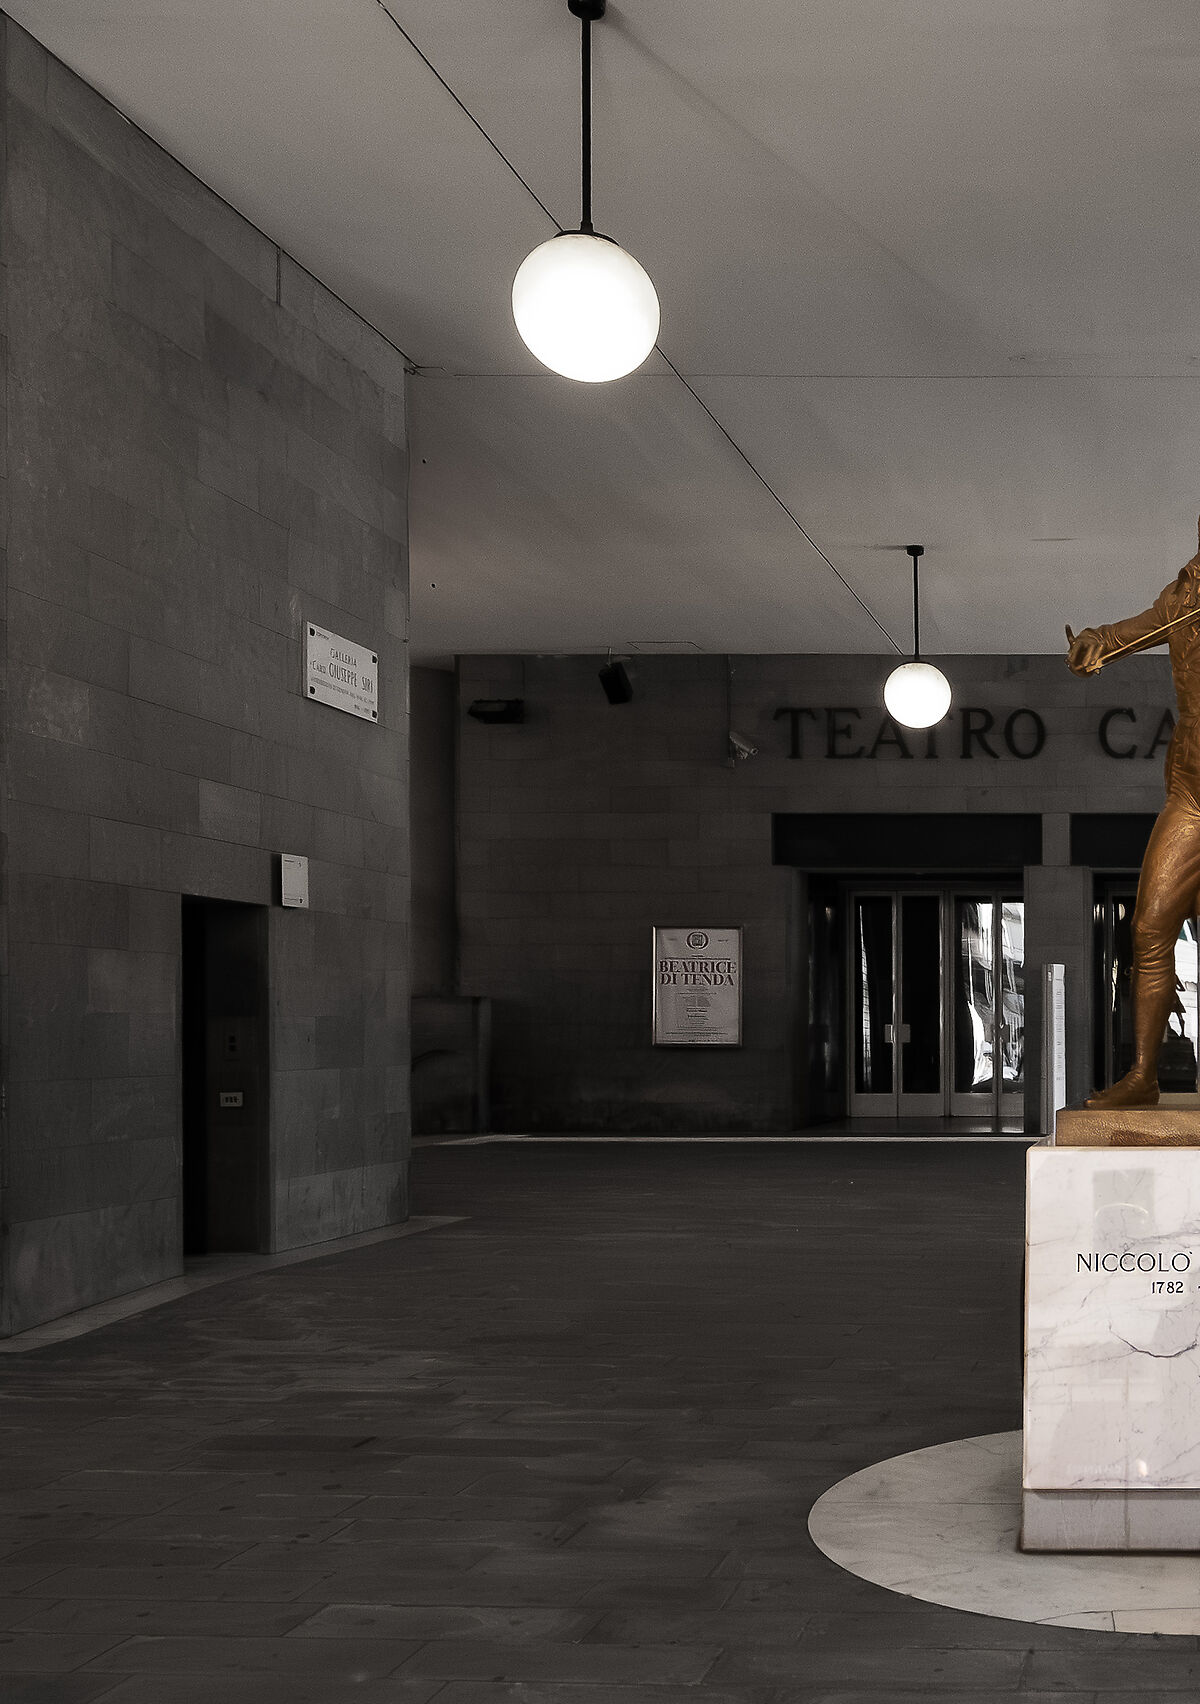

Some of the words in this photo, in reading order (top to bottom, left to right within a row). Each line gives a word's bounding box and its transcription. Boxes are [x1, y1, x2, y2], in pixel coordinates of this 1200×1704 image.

[330, 648, 358, 667] GALLERIA
[328, 662, 358, 687] GIUSEPPE
[659, 960, 737, 974] BEATRICE
[660, 974, 677, 986] DI
[681, 973, 735, 986] TENDA
[1151, 1280, 1184, 1294] 1782
